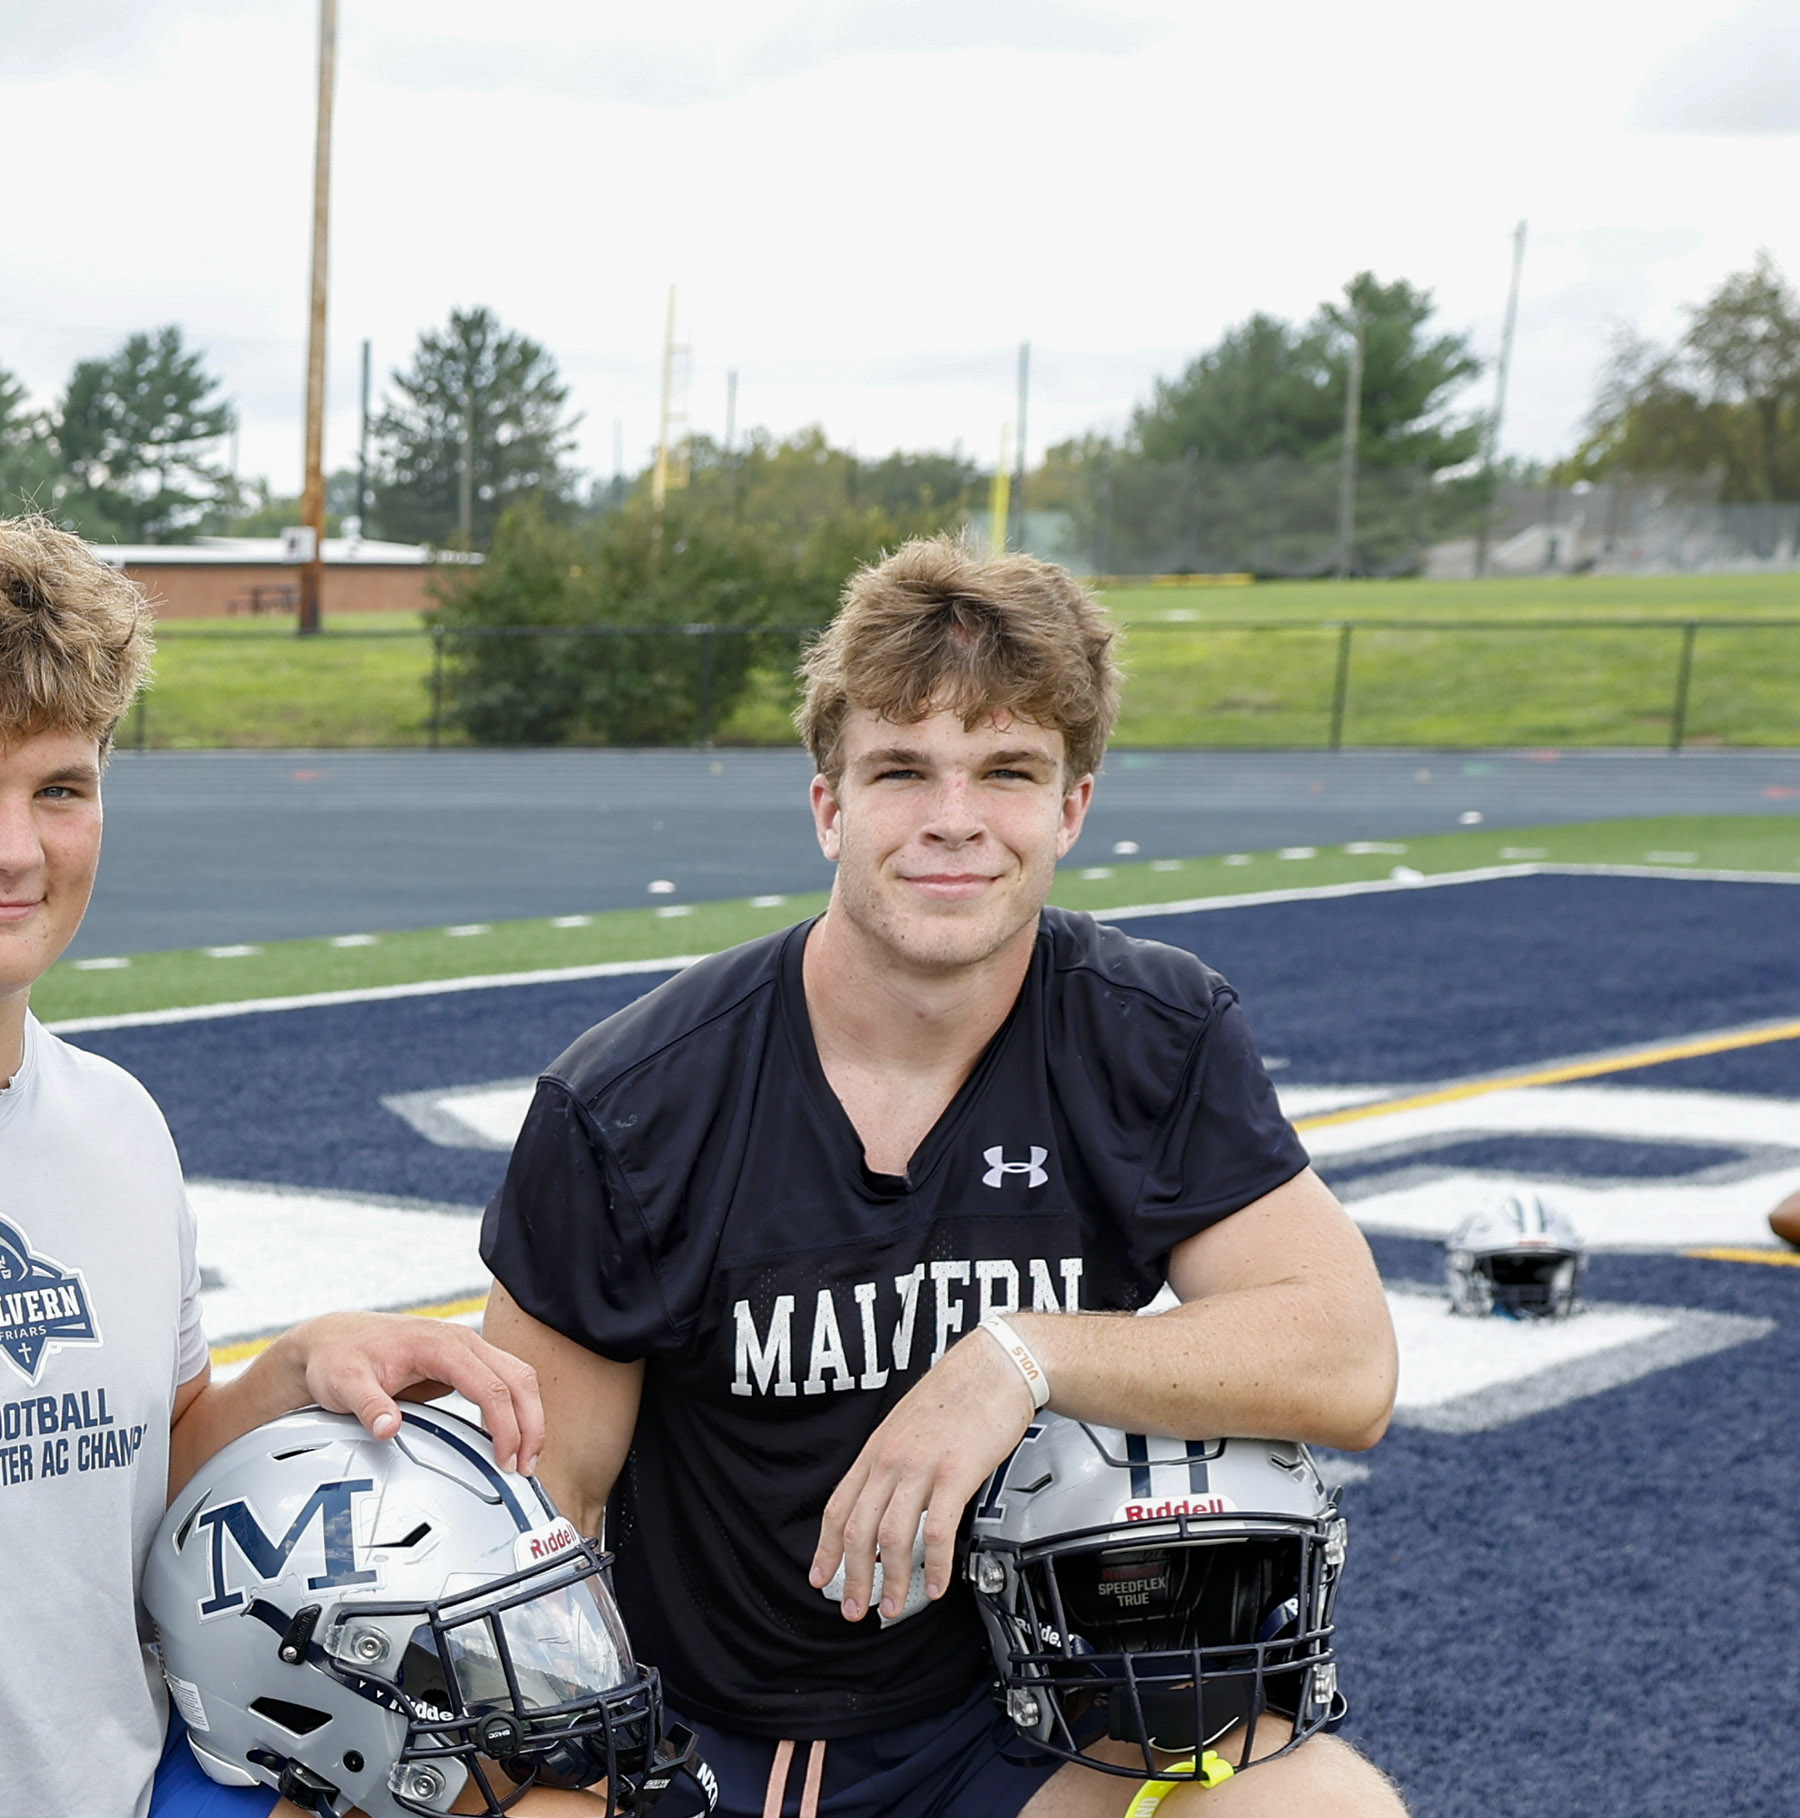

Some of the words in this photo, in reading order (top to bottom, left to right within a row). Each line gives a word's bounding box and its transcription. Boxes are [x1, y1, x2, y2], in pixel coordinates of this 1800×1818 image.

[1011, 1346, 1039, 1381] VOLS
[41, 1438, 69, 1478] AC
[78, 1423, 148, 1471] CHAMP
[1125, 1499, 1224, 1522] Riddell
[198, 1476, 384, 1622] M
[530, 1523, 577, 1560] Riddell
[1097, 1576, 1168, 1596] SPEEDFLEX
[1116, 1592, 1150, 1608] TRUE
